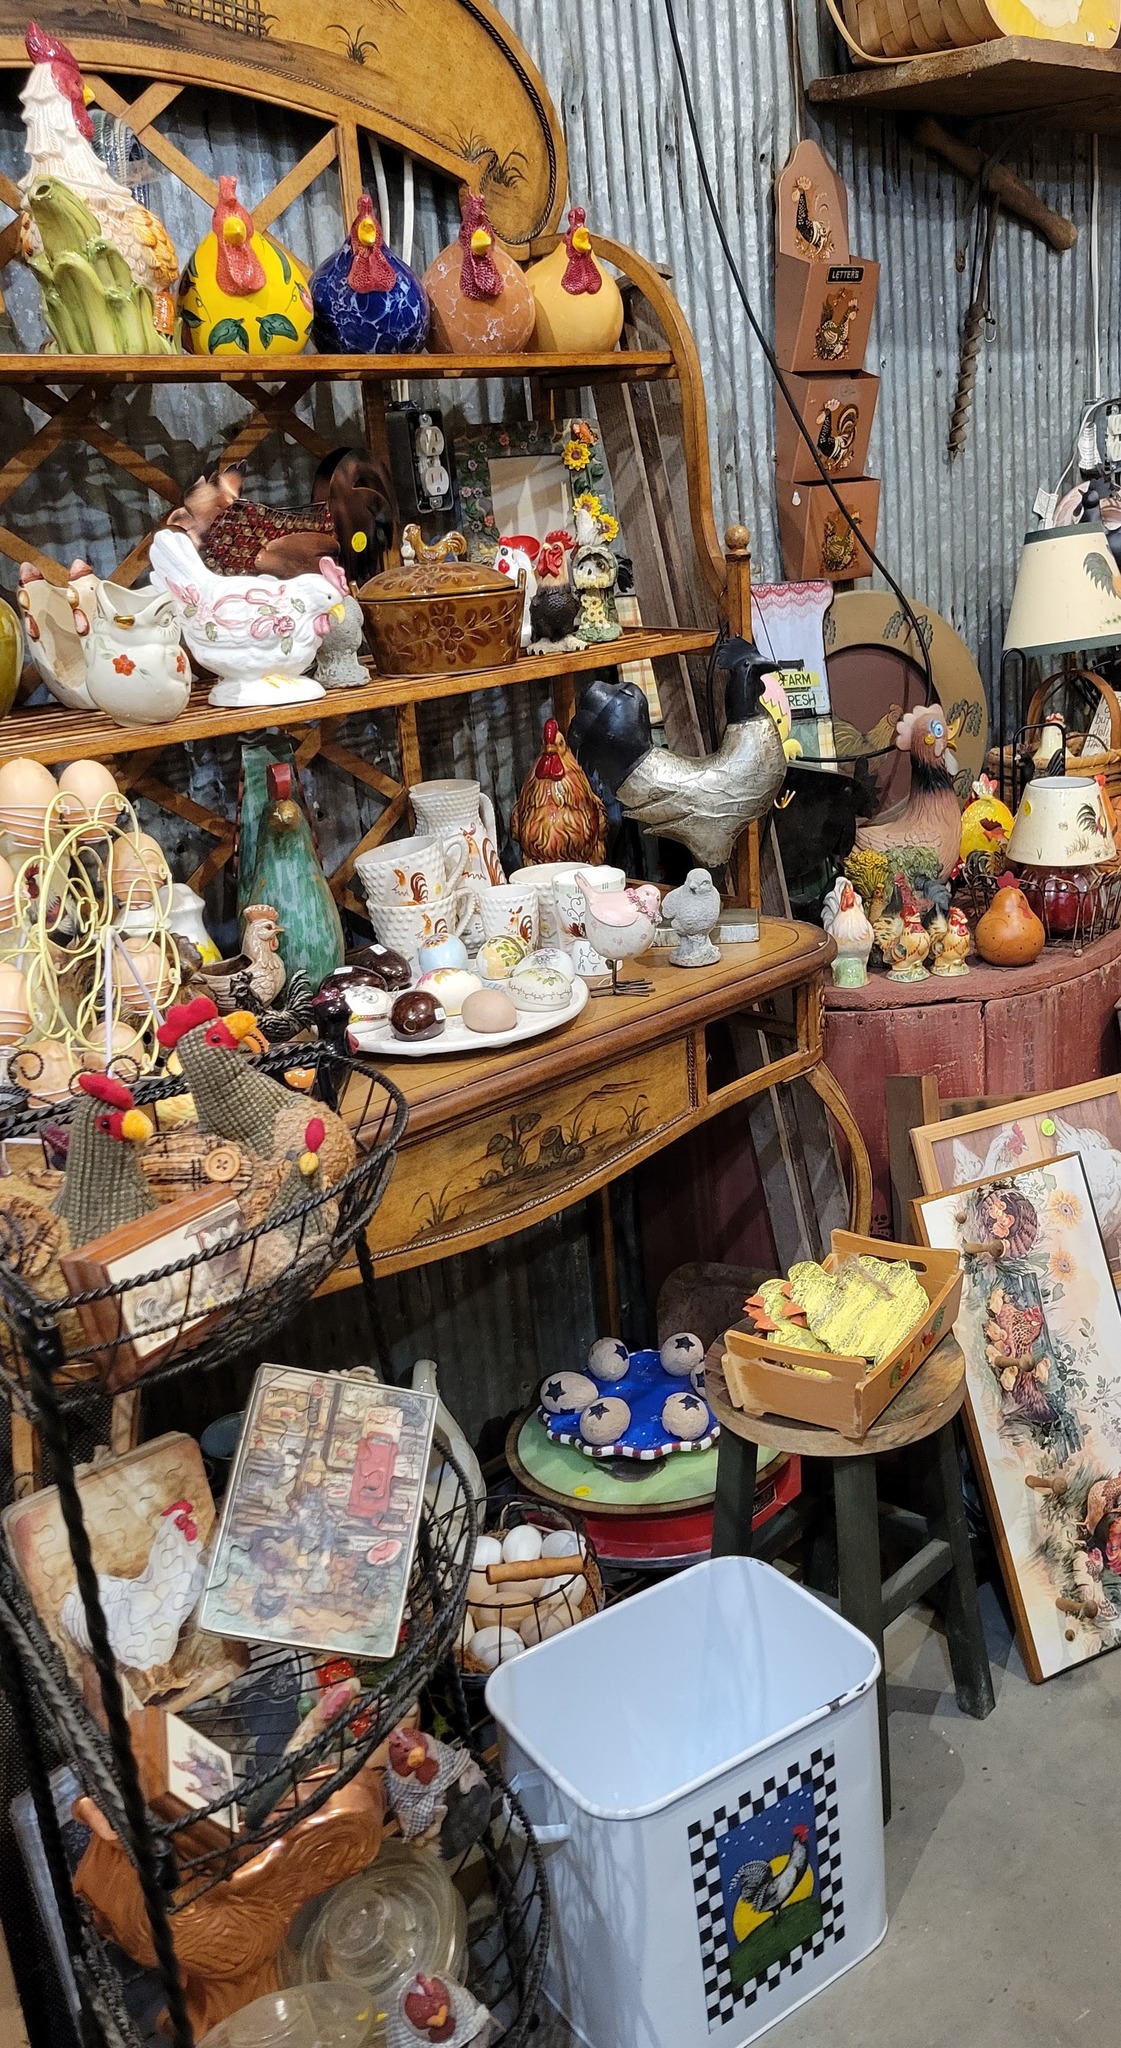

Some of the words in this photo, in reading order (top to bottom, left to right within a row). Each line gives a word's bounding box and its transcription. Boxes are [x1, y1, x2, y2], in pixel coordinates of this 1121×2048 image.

[831, 270, 860, 279] LETTERS
[782, 673, 812, 686] FARM
[786, 693, 817, 707] RESH
